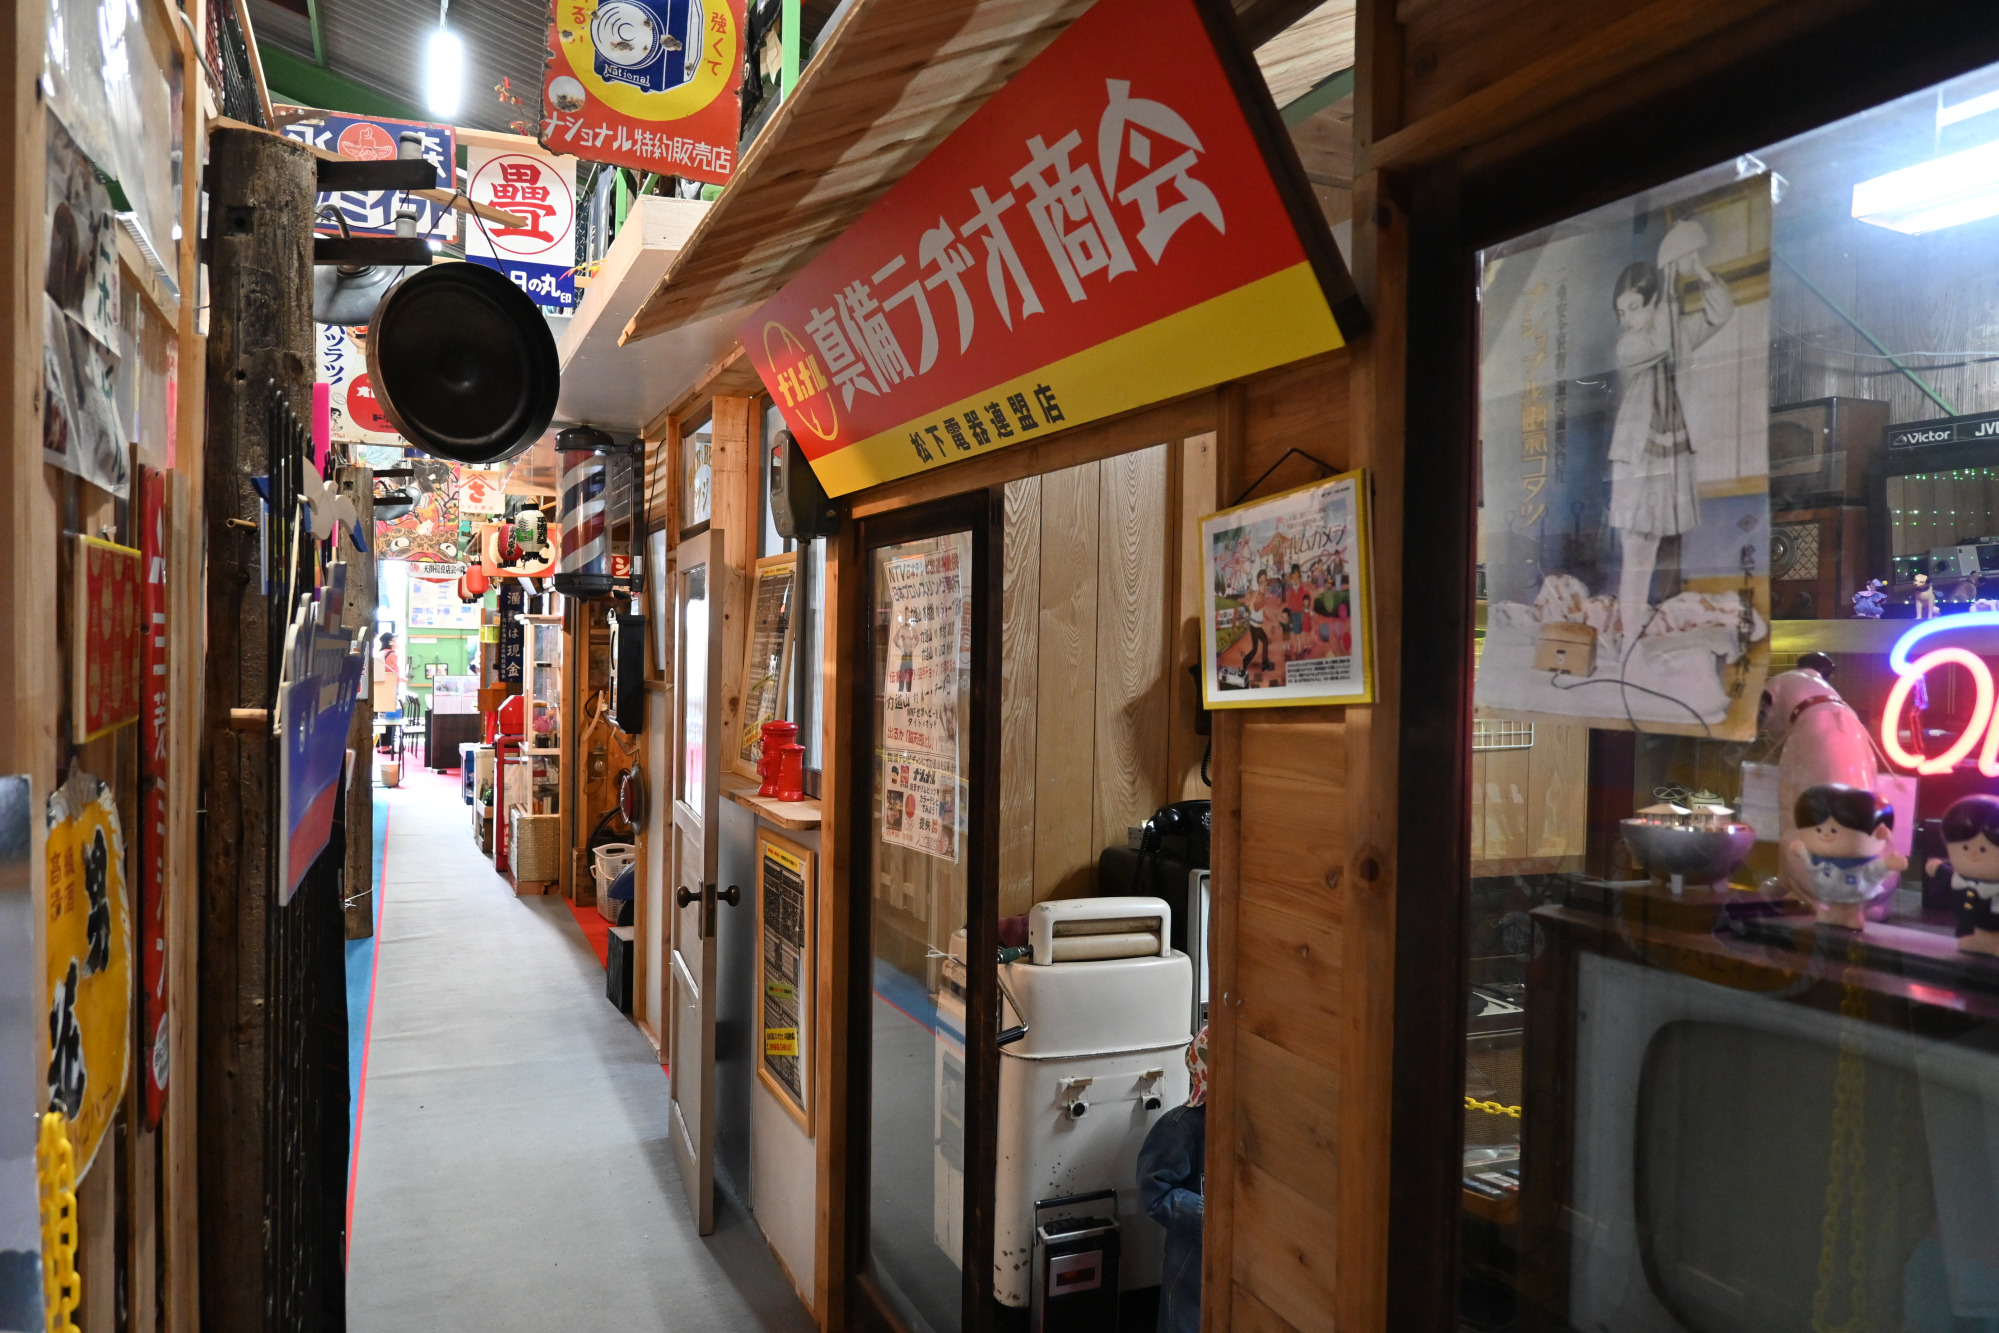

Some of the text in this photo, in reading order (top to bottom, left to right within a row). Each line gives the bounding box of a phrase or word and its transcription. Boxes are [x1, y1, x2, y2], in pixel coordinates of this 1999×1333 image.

[604, 64, 651, 86] National
[708, 11, 728, 77] 強くて
[546, 110, 732, 174] ナショナル特約販売店
[806, 78, 1226, 413] 真備ラヂオ商会
[909, 383, 1066, 464] 松下電器連盟店
[1907, 430, 1951, 444] Victor
[887, 693, 910, 711] 力道山
